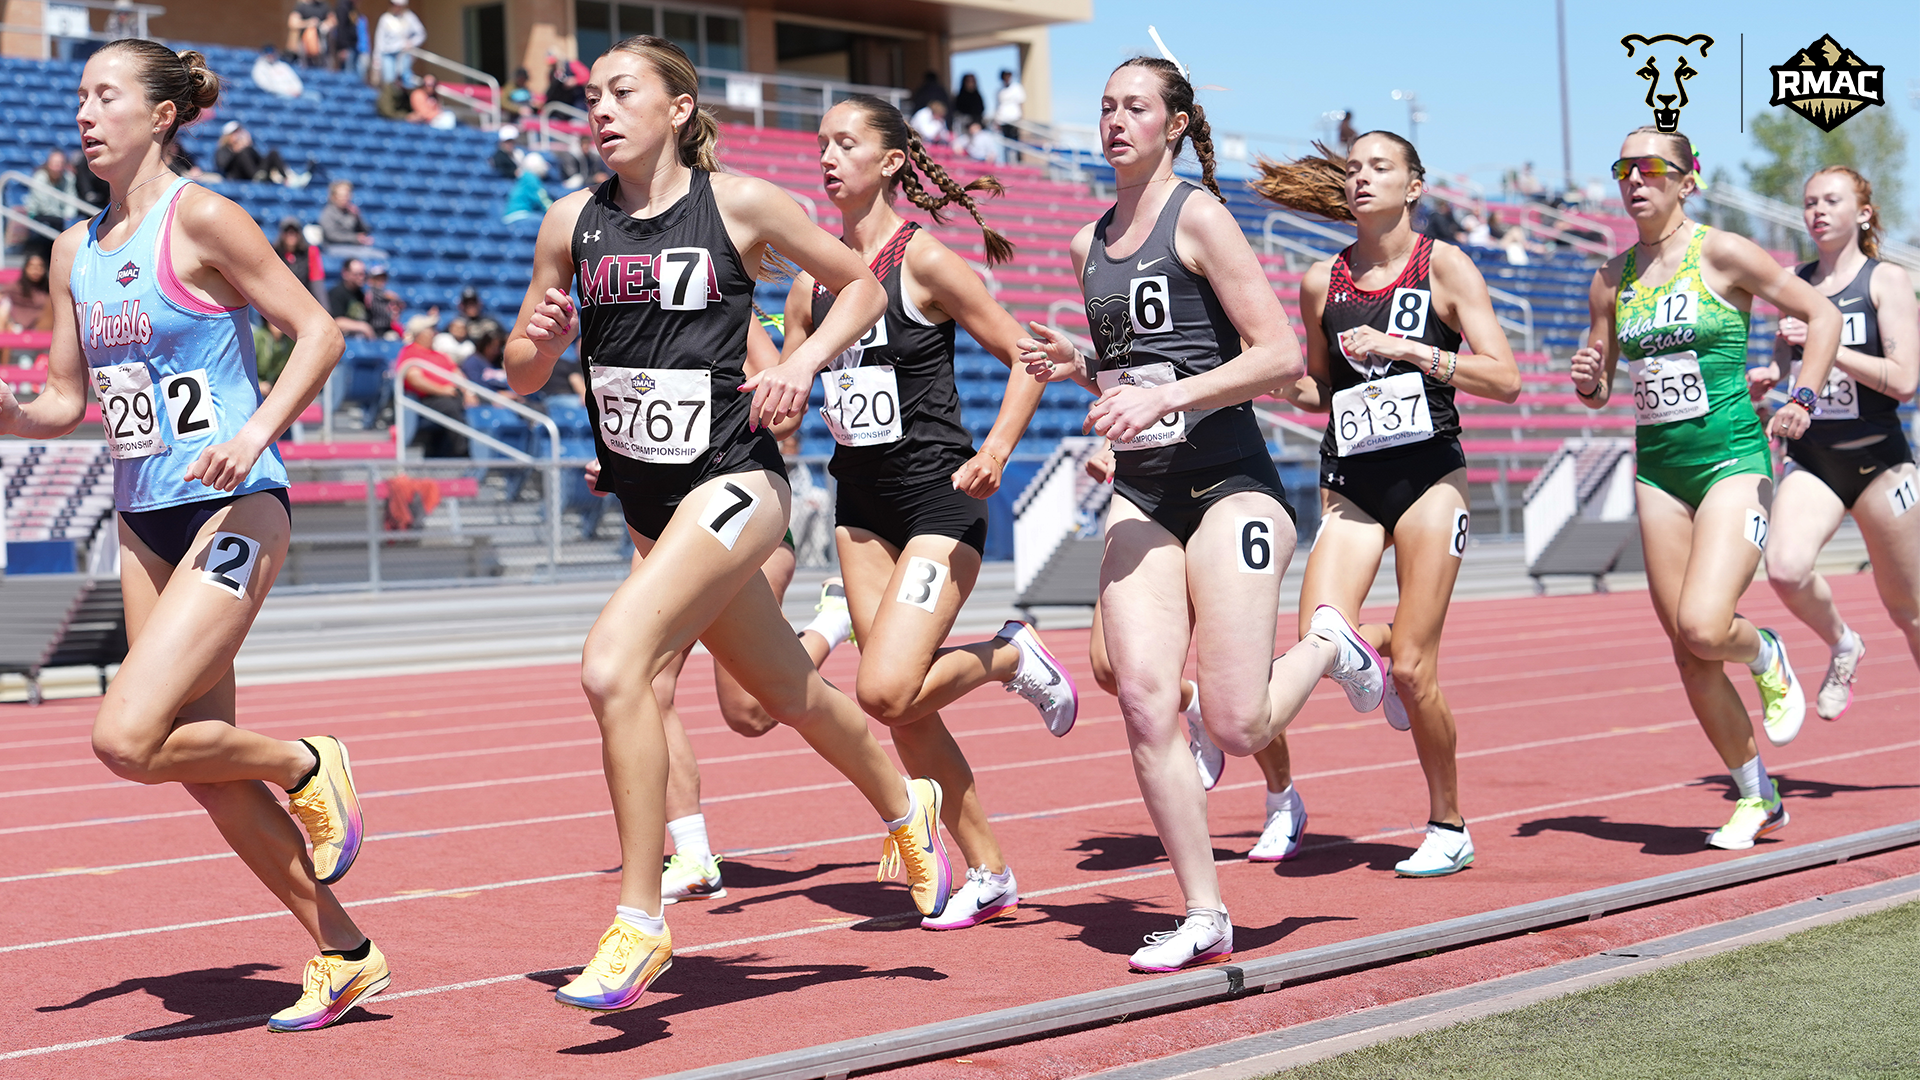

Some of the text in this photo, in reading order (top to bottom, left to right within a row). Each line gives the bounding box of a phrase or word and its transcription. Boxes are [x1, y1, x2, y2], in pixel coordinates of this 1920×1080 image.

[117, 268, 139, 281] RMAC
[667, 252, 700, 306] 7
[90, 300, 153, 350] Pueblo
[1135, 281, 1165, 330] 6
[1395, 292, 1422, 331] 8
[1663, 294, 1688, 323] 12
[1617, 316, 1655, 343] Ada
[1639, 326, 1696, 356] State
[632, 379, 655, 388] RMAC
[1634, 373, 1702, 411] 5558
[168, 377, 210, 435] 2
[603, 395, 705, 442] 5767
[1340, 394, 1421, 441] 6137
[610, 439, 697, 456] RMAC CHAMPIONSHIP
[710, 482, 753, 533] 7
[1894, 481, 1915, 510] 11
[1242, 521, 1270, 570] 6
[1455, 513, 1468, 554] 8
[1753, 515, 1768, 550] 12
[209, 536, 250, 592] 2
[906, 562, 937, 604] 3
